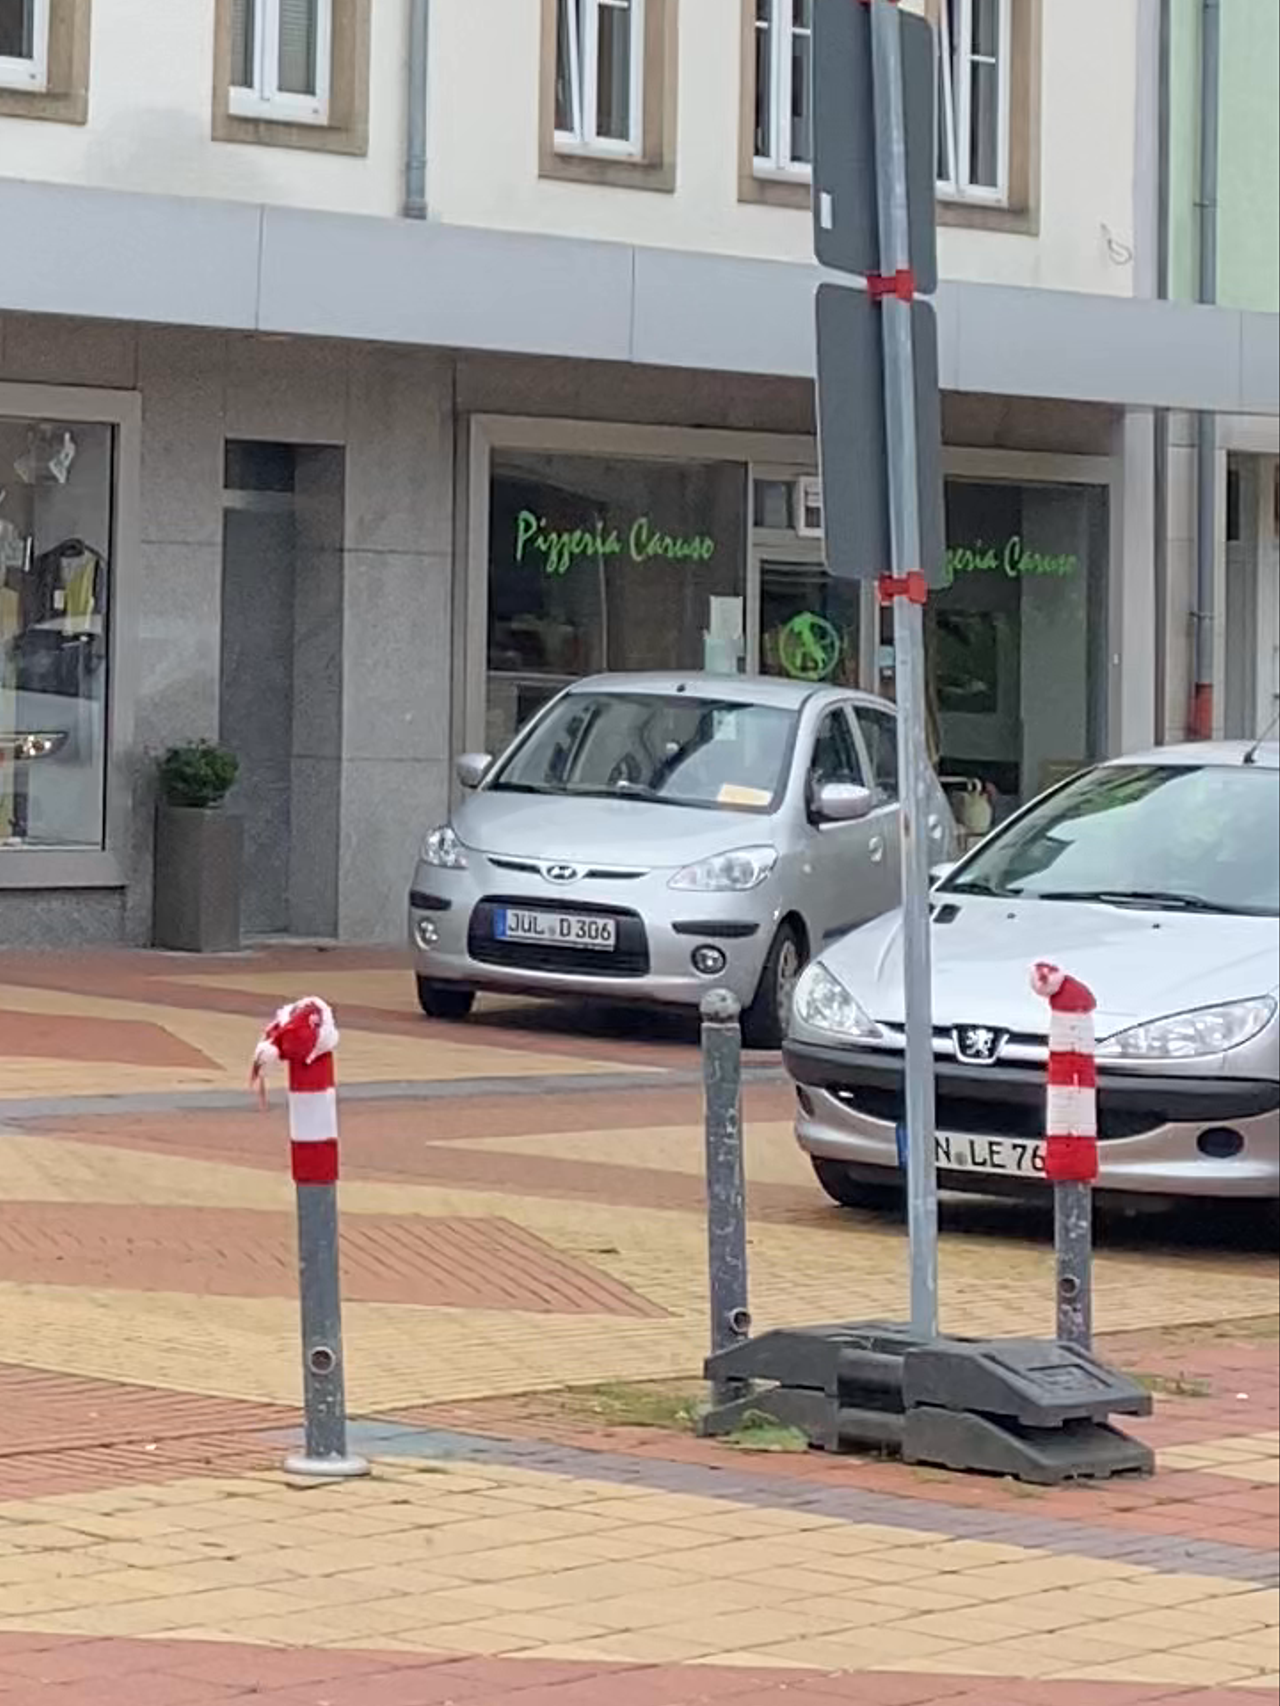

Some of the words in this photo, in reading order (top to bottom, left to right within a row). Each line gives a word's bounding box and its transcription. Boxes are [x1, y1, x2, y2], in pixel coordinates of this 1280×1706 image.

[515, 510, 622, 574] Pizzeria
[629, 517, 716, 562] Caruso
[945, 538, 1001, 584] zeria
[559, 917, 572, 938] D
[575, 919, 612, 942] 306
[968, 1139, 1006, 1169] LE
[1011, 1143, 1046, 1172] 76
